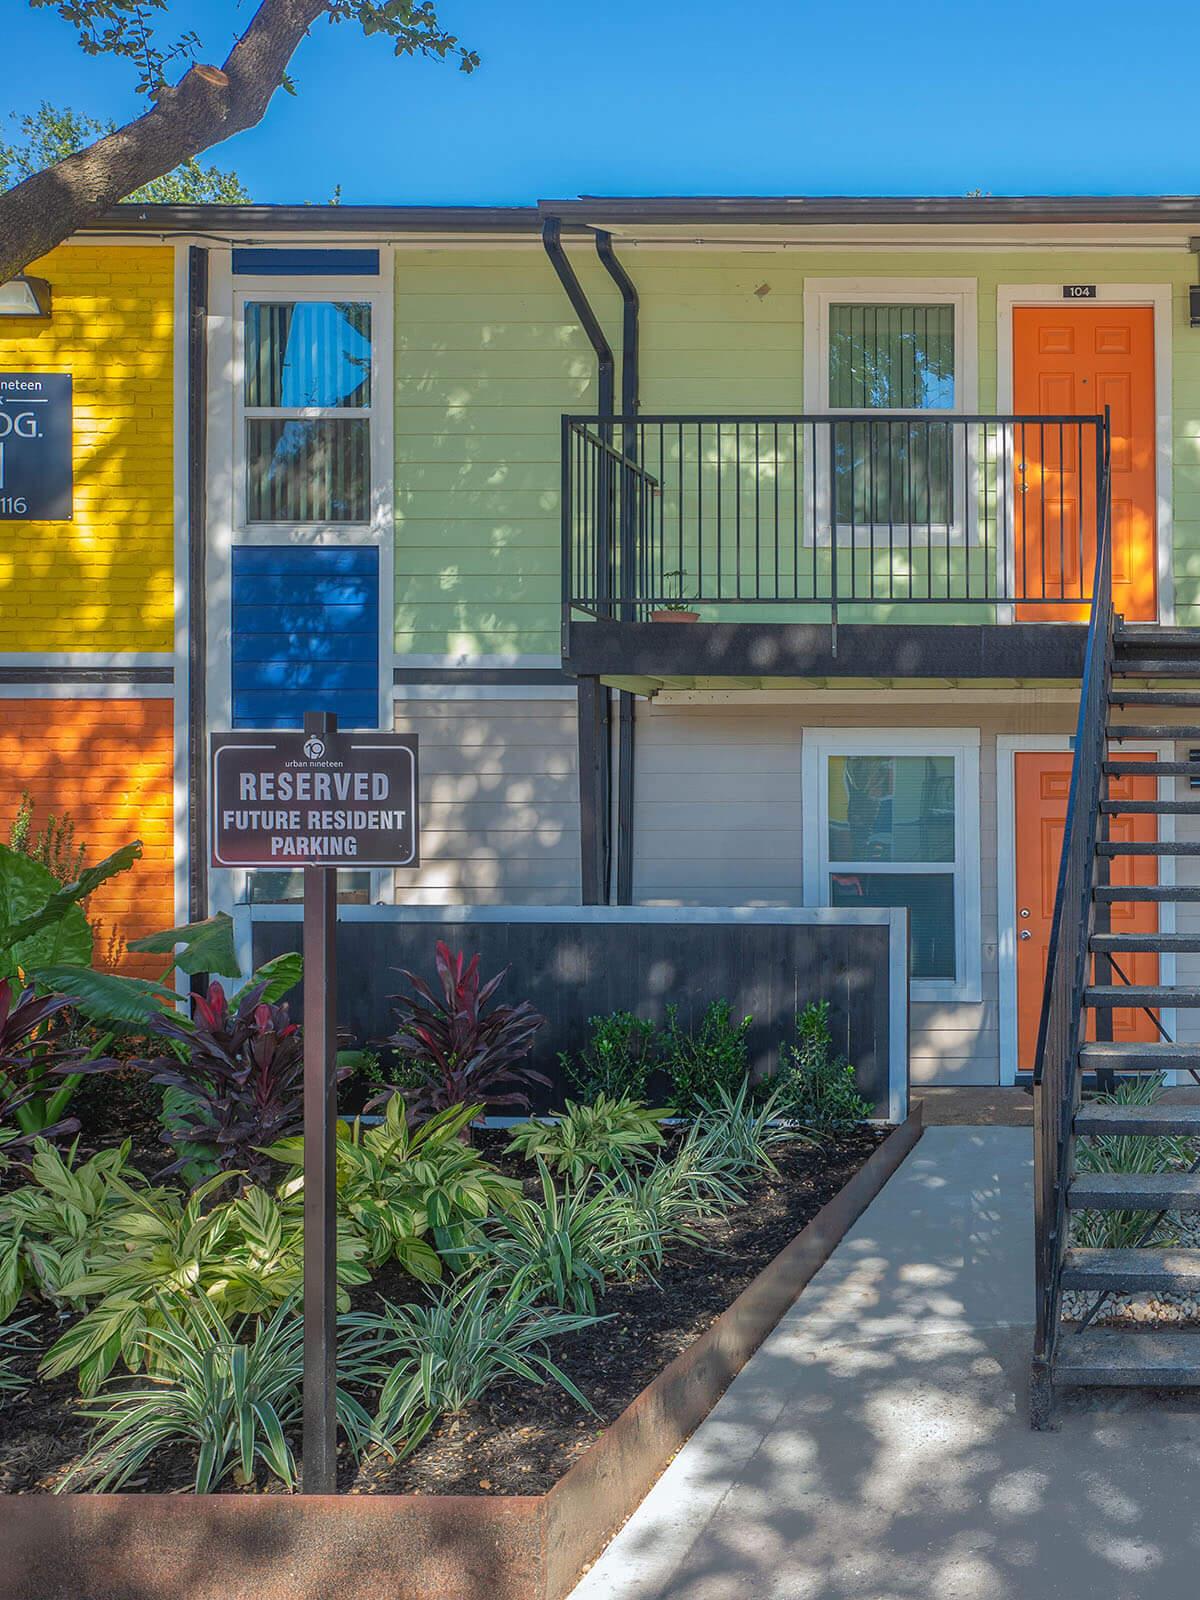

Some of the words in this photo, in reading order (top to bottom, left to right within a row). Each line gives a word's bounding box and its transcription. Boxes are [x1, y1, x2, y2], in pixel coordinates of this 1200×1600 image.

[1070, 287, 1090, 297] 104
[285, 760, 308, 768] urban
[309, 760, 344, 768] nineteen
[239, 772, 390, 801] RESERVED
[223, 810, 300, 830] FUTURE
[307, 810, 406, 830] RESIDENT
[271, 836, 357, 856] PARKING
